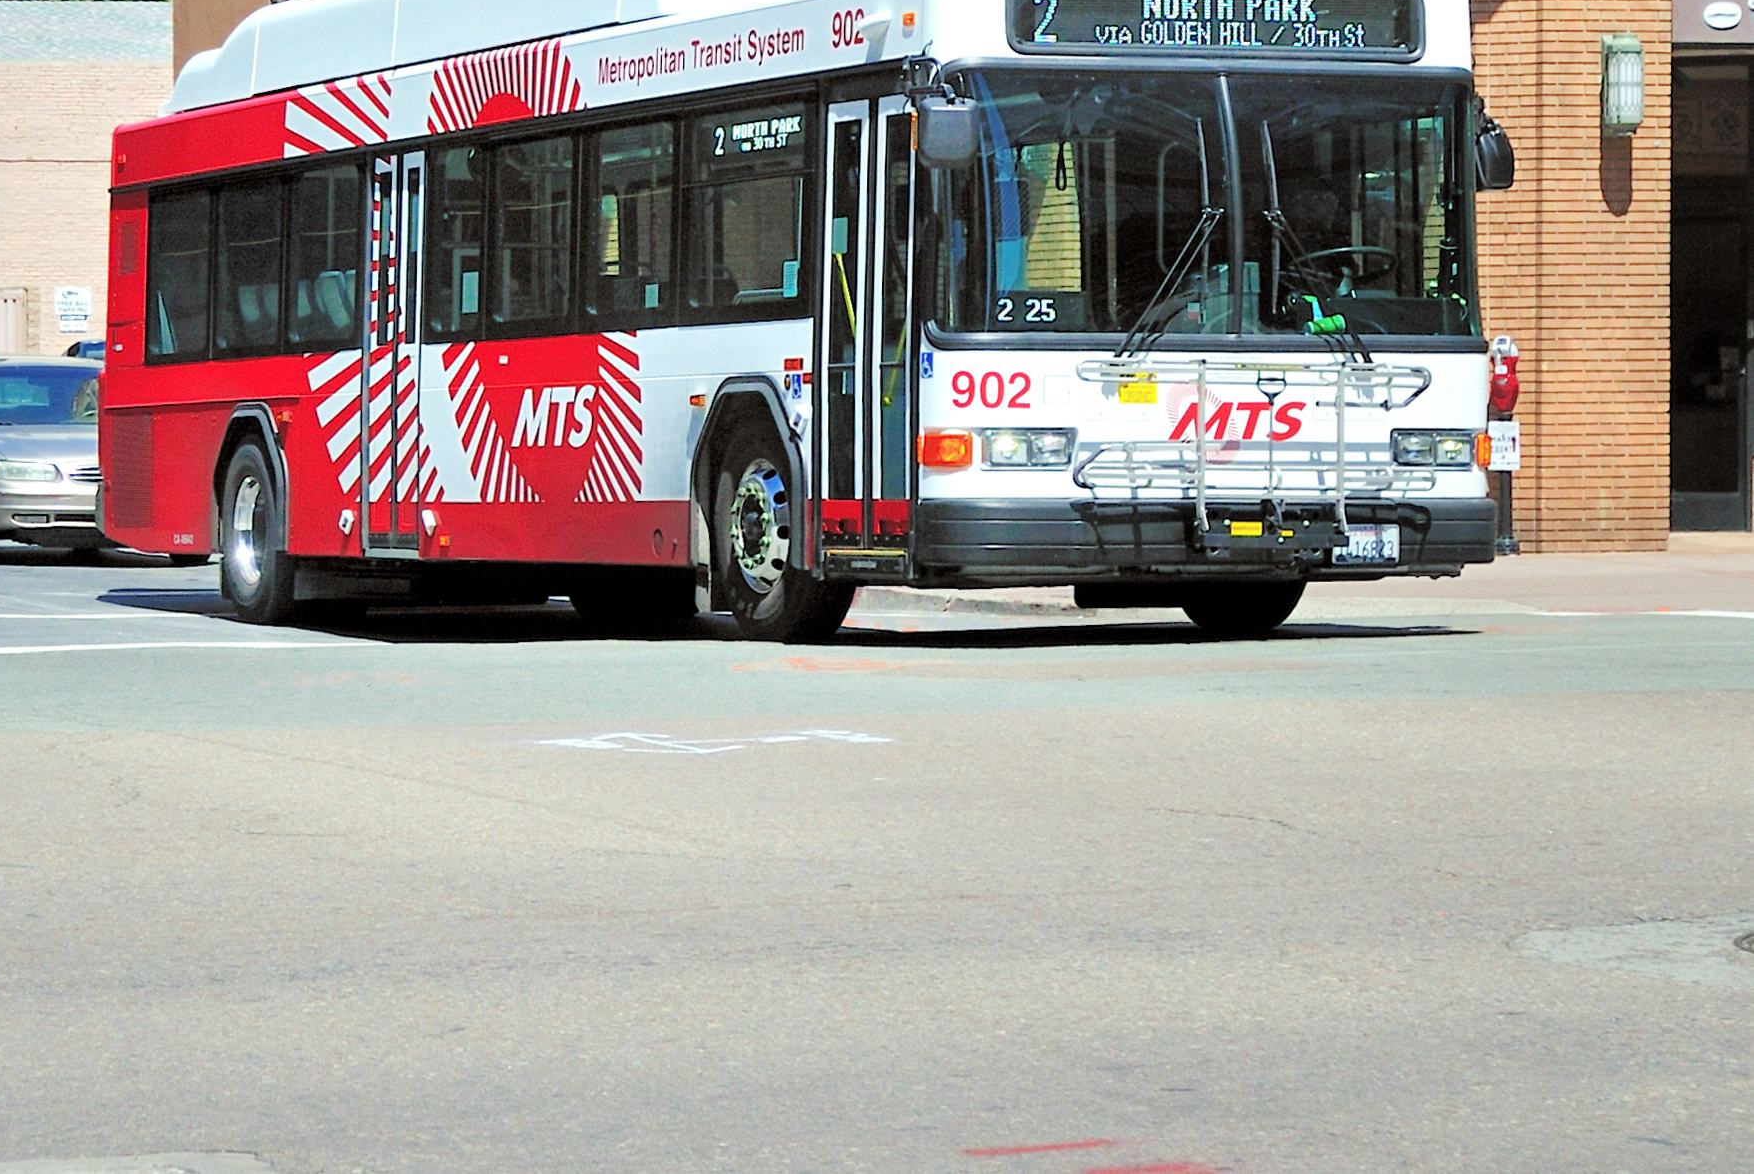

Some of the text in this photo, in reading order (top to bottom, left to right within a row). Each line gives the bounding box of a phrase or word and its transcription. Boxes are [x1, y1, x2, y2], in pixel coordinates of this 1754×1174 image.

[831, 8, 866, 49] 902
[1095, 26, 1133, 44] VIA
[1141, 20, 1212, 46] GOLDEN
[1219, 21, 1263, 47] HILL
[598, 28, 805, 86] Metropolitan Transit System
[714, 126, 725, 156] 2
[732, 115, 802, 141] NORTH PARK
[997, 298, 1057, 322] 2 25
[951, 370, 1031, 408] 902
[510, 384, 596, 449] MTS
[1168, 402, 1307, 442] MTS
